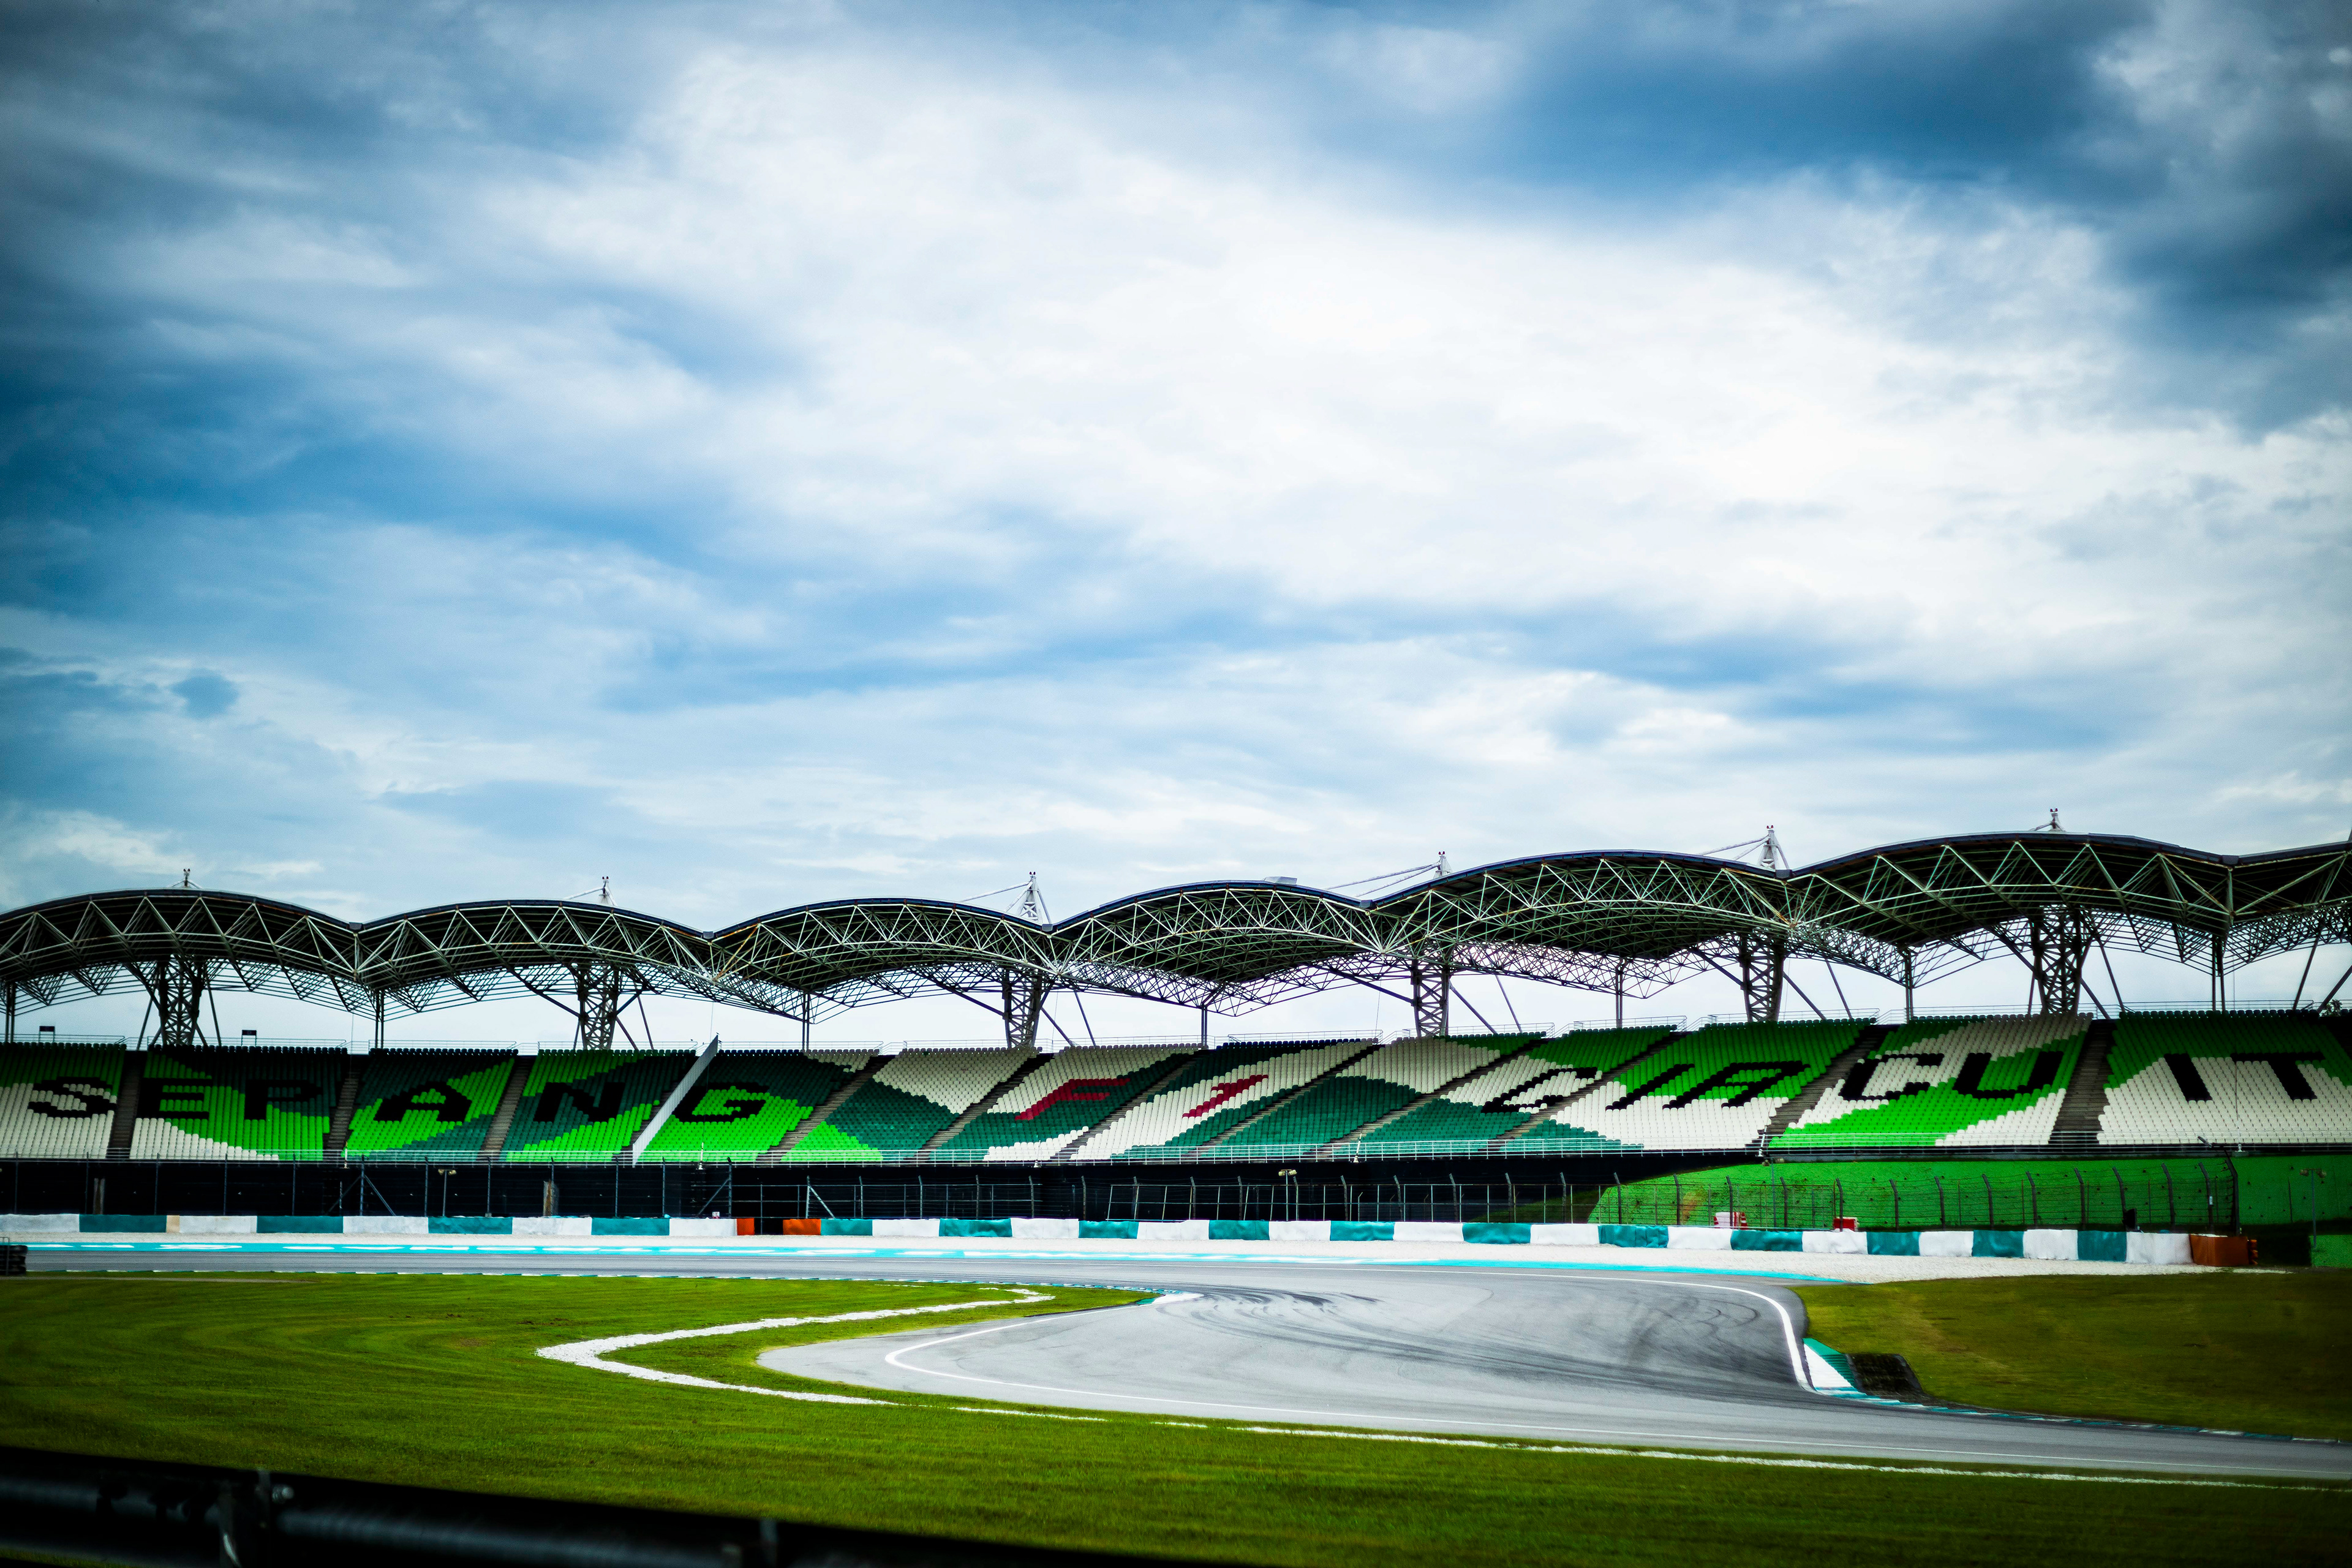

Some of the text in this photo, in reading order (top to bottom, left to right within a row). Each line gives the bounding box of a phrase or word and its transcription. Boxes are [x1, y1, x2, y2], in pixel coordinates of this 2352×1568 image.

[27, 1050, 2326, 1122] SEPANG F1 CIRCUIT
